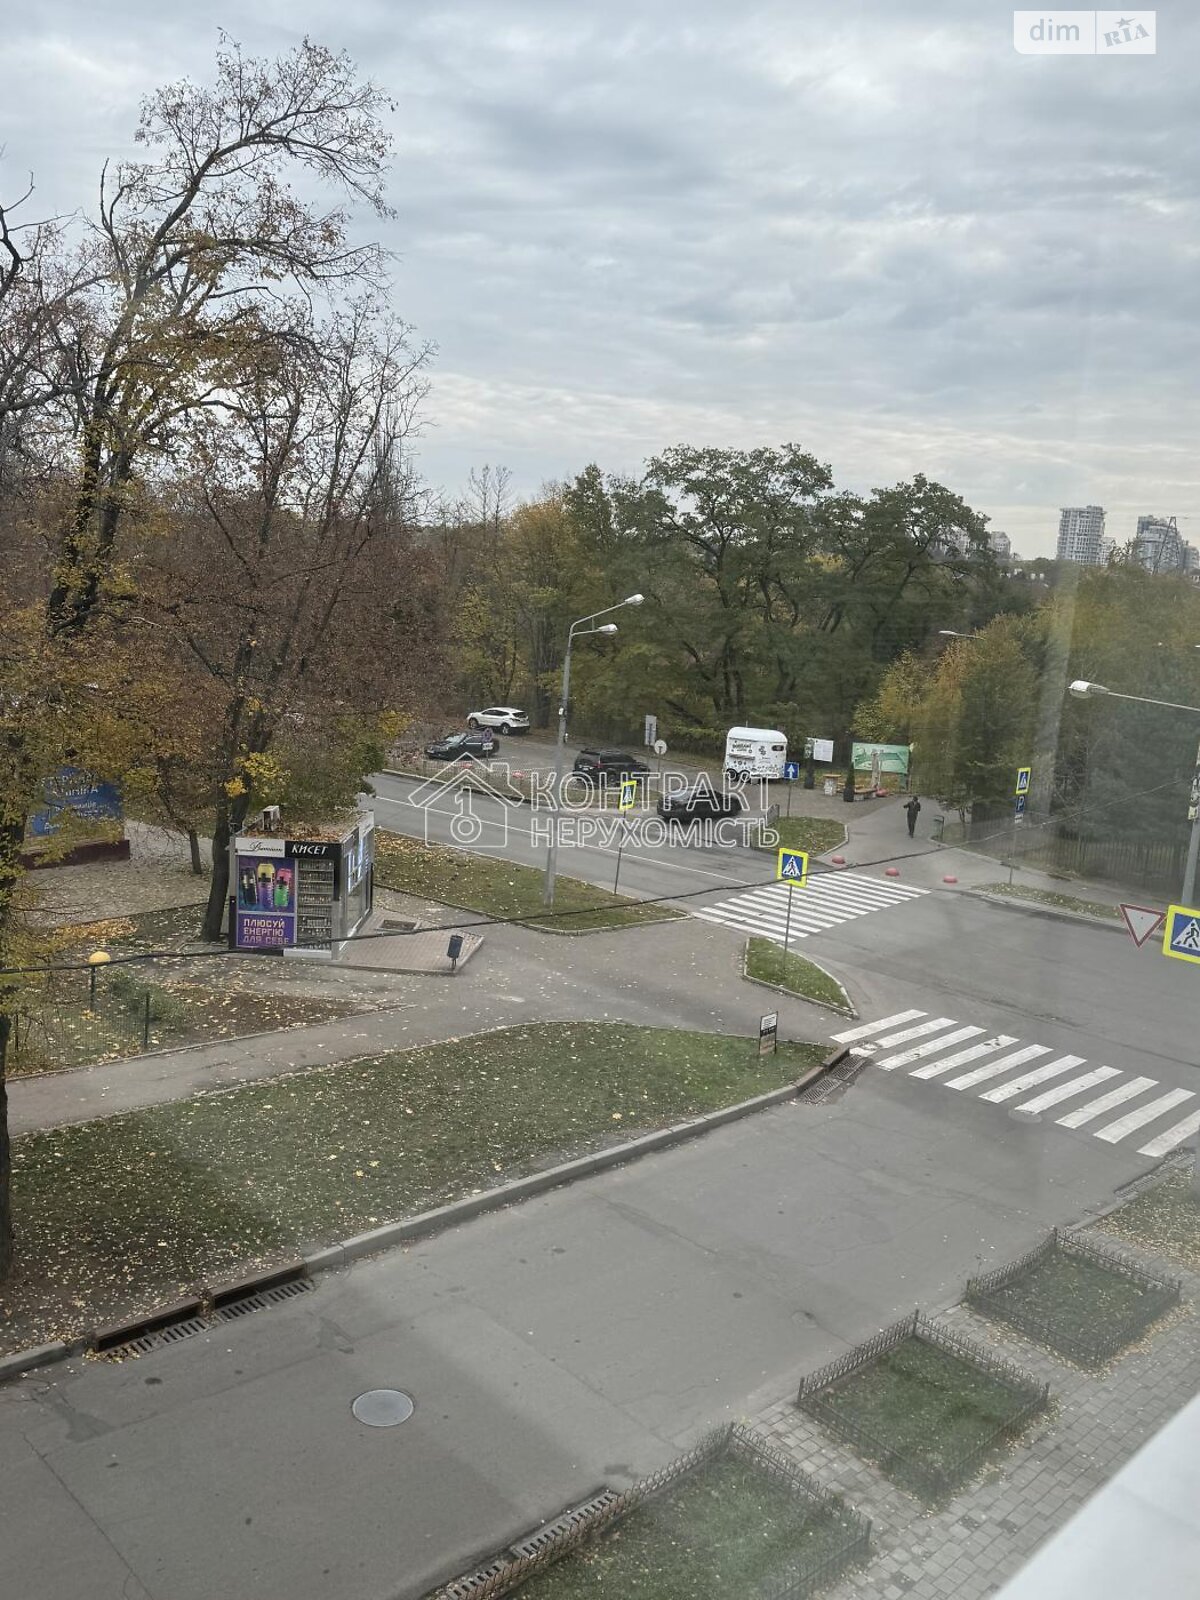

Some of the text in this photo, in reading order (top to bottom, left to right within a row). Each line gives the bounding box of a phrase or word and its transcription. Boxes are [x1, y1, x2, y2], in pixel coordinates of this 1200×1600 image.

[291, 843, 329, 855] КИСЕТ
[243, 918, 286, 928] ПЛЮСУЙ
[243, 927, 284, 937] ЕНЕРГІЮ
